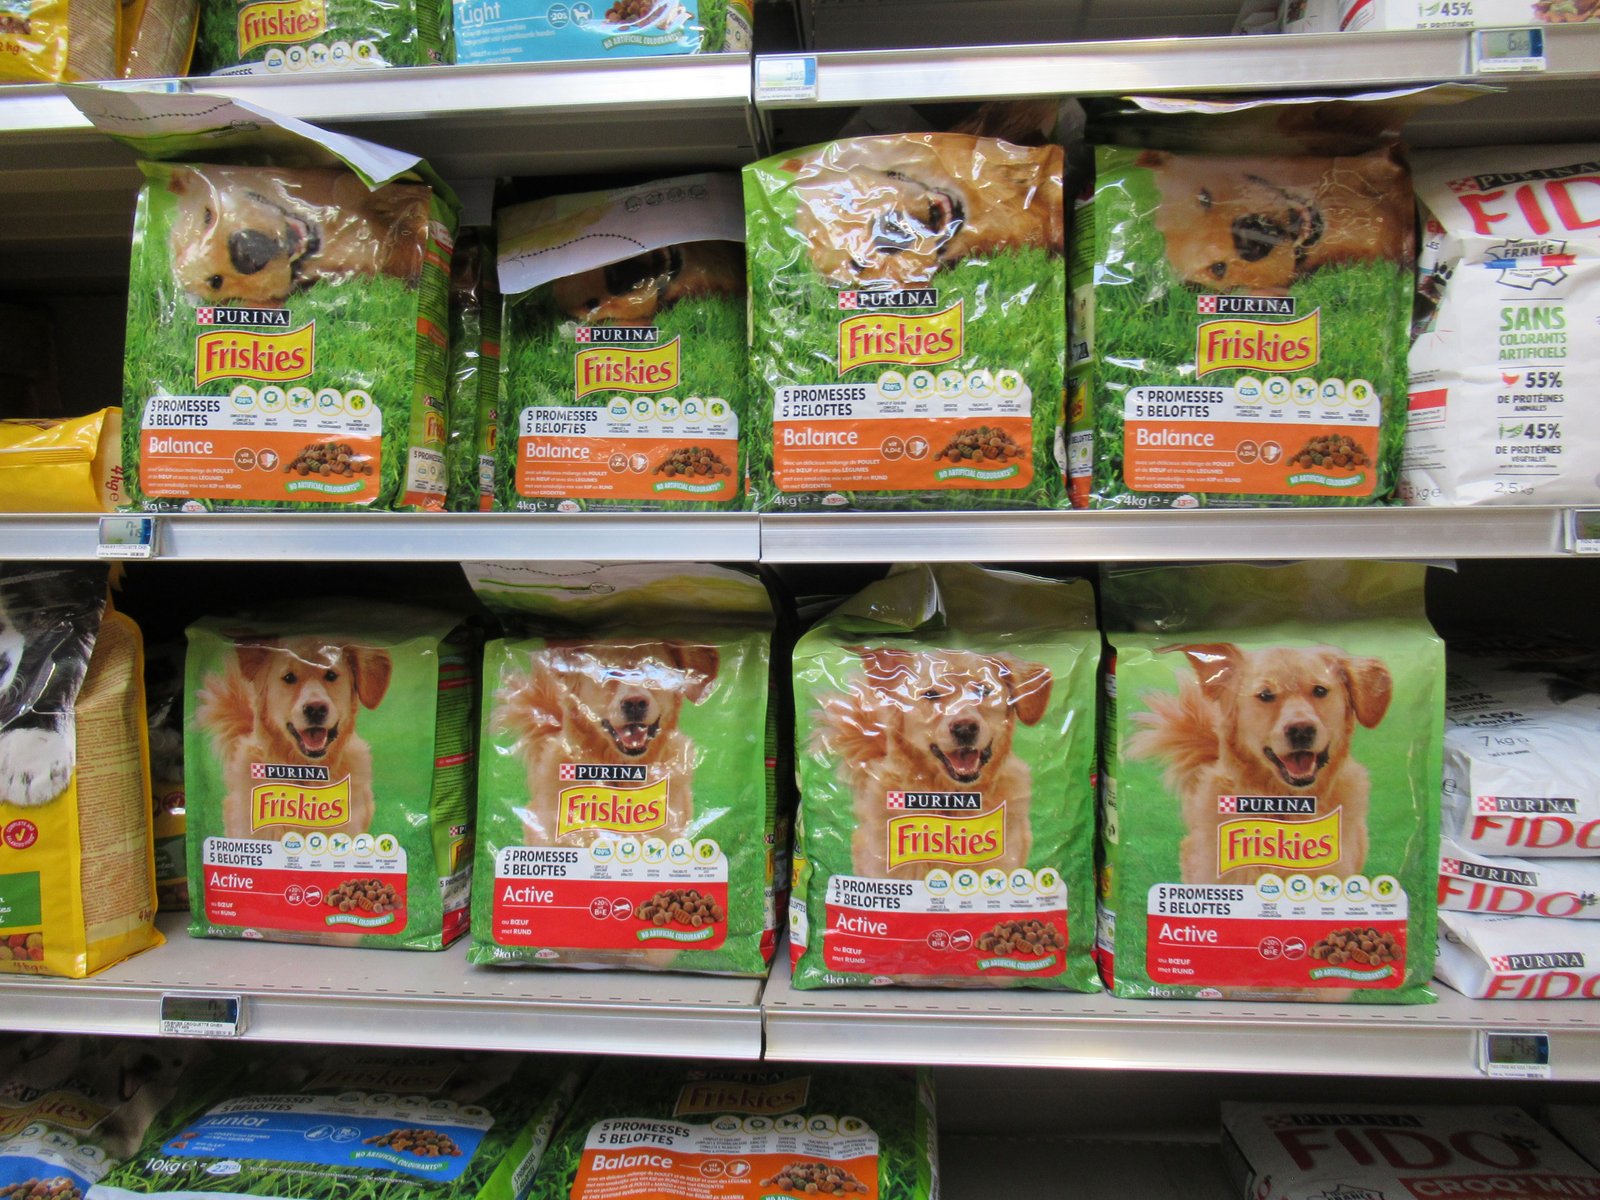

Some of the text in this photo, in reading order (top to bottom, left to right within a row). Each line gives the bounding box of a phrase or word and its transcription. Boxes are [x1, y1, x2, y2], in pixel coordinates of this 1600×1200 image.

[459, 1, 500, 28] Light
[1440, 1, 1473, 16] 45%
[244, 8, 320, 43] Friskies
[1481, 163, 1593, 189] PURINA
[1504, 244, 1555, 258] FRANCE
[860, 290, 934, 306] PURINA
[1219, 299, 1291, 313] PURINA
[215, 309, 289, 325] PURINA
[1499, 306, 1566, 331] SANS
[592, 329, 656, 341] PURINA
[849, 323, 954, 358] Friskies
[1499, 332, 1567, 346] COLORANTS
[1207, 328, 1310, 363] Friskies
[1498, 346, 1567, 360] ARTIFICIELS
[205, 339, 305, 373] Friskies
[584, 355, 672, 386] Friskies
[1525, 371, 1563, 388] 55%
[783, 388, 866, 402] 5 PROMESSES
[1137, 390, 1224, 403] 5 PROMESSES
[1497, 393, 1564, 404] DE PROTÉINES
[150, 399, 221, 413] 5 PROMESSES
[782, 403, 853, 417] 5 BELOFTES
[1136, 404, 1210, 418] 5 BELOFTES
[149, 413, 209, 427] 5 BELOFTES
[527, 410, 598, 422] 5 PROMESSES
[527, 422, 587, 434] 5 BELOFTES
[1524, 423, 1561, 439] 45%
[783, 428, 858, 447] Balance
[1136, 428, 1215, 446] Balance
[149, 436, 213, 454] Balance
[526, 442, 590, 460] Balance
[1495, 443, 1562, 454] DE PROTÉINES
[516, 500, 536, 513] 4kg
[773, 495, 797, 508] 4kg
[1123, 496, 1147, 508] 4kg
[1478, 735, 1489, 747] 7
[267, 765, 327, 780] PURINA
[578, 765, 645, 780] PURINA
[259, 791, 344, 821] Friskies
[907, 793, 978, 808] PURINA
[1240, 798, 1313, 812] PURINA
[1499, 799, 1574, 813] PURINA
[567, 794, 660, 825] Friskies
[210, 839, 273, 855] 5 PROMESSES
[897, 823, 997, 856] Friskies
[1228, 827, 1332, 861] Friskies
[209, 852, 263, 867] 5 BELOFTES
[504, 850, 578, 864] 5 PROMESSES
[503, 864, 567, 877] 5 BELOFTES
[1462, 864, 1536, 886] PURINA
[210, 871, 253, 890] Active
[834, 878, 913, 896] 5 PROMESSES
[503, 885, 554, 904] Active
[834, 891, 901, 909] 5 BELOFTES
[1159, 887, 1244, 901] 5 PROMESSES
[1438, 875, 1585, 917] FIDO
[1159, 901, 1231, 916] 5 BELOFTES
[836, 912, 888, 935] Active
[513, 928, 532, 936] RUND
[1158, 923, 1218, 943] Active
[844, 956, 866, 964] RUND
[1511, 952, 1583, 969] PURINA
[1172, 967, 1194, 975] RUND
[1148, 986, 1170, 998] 4kg
[602, 1121, 691, 1138] 5 PROMESSES
[599, 1133, 674, 1146] 5 BELOFTES
[355, 1151, 366, 1159] NO
[367, 1151, 398, 1163] ARTIFICIAL
[1273, 1128, 1538, 1172] FIDO
[145, 1157, 182, 1175] 10kg
[592, 1153, 673, 1171] Balance
